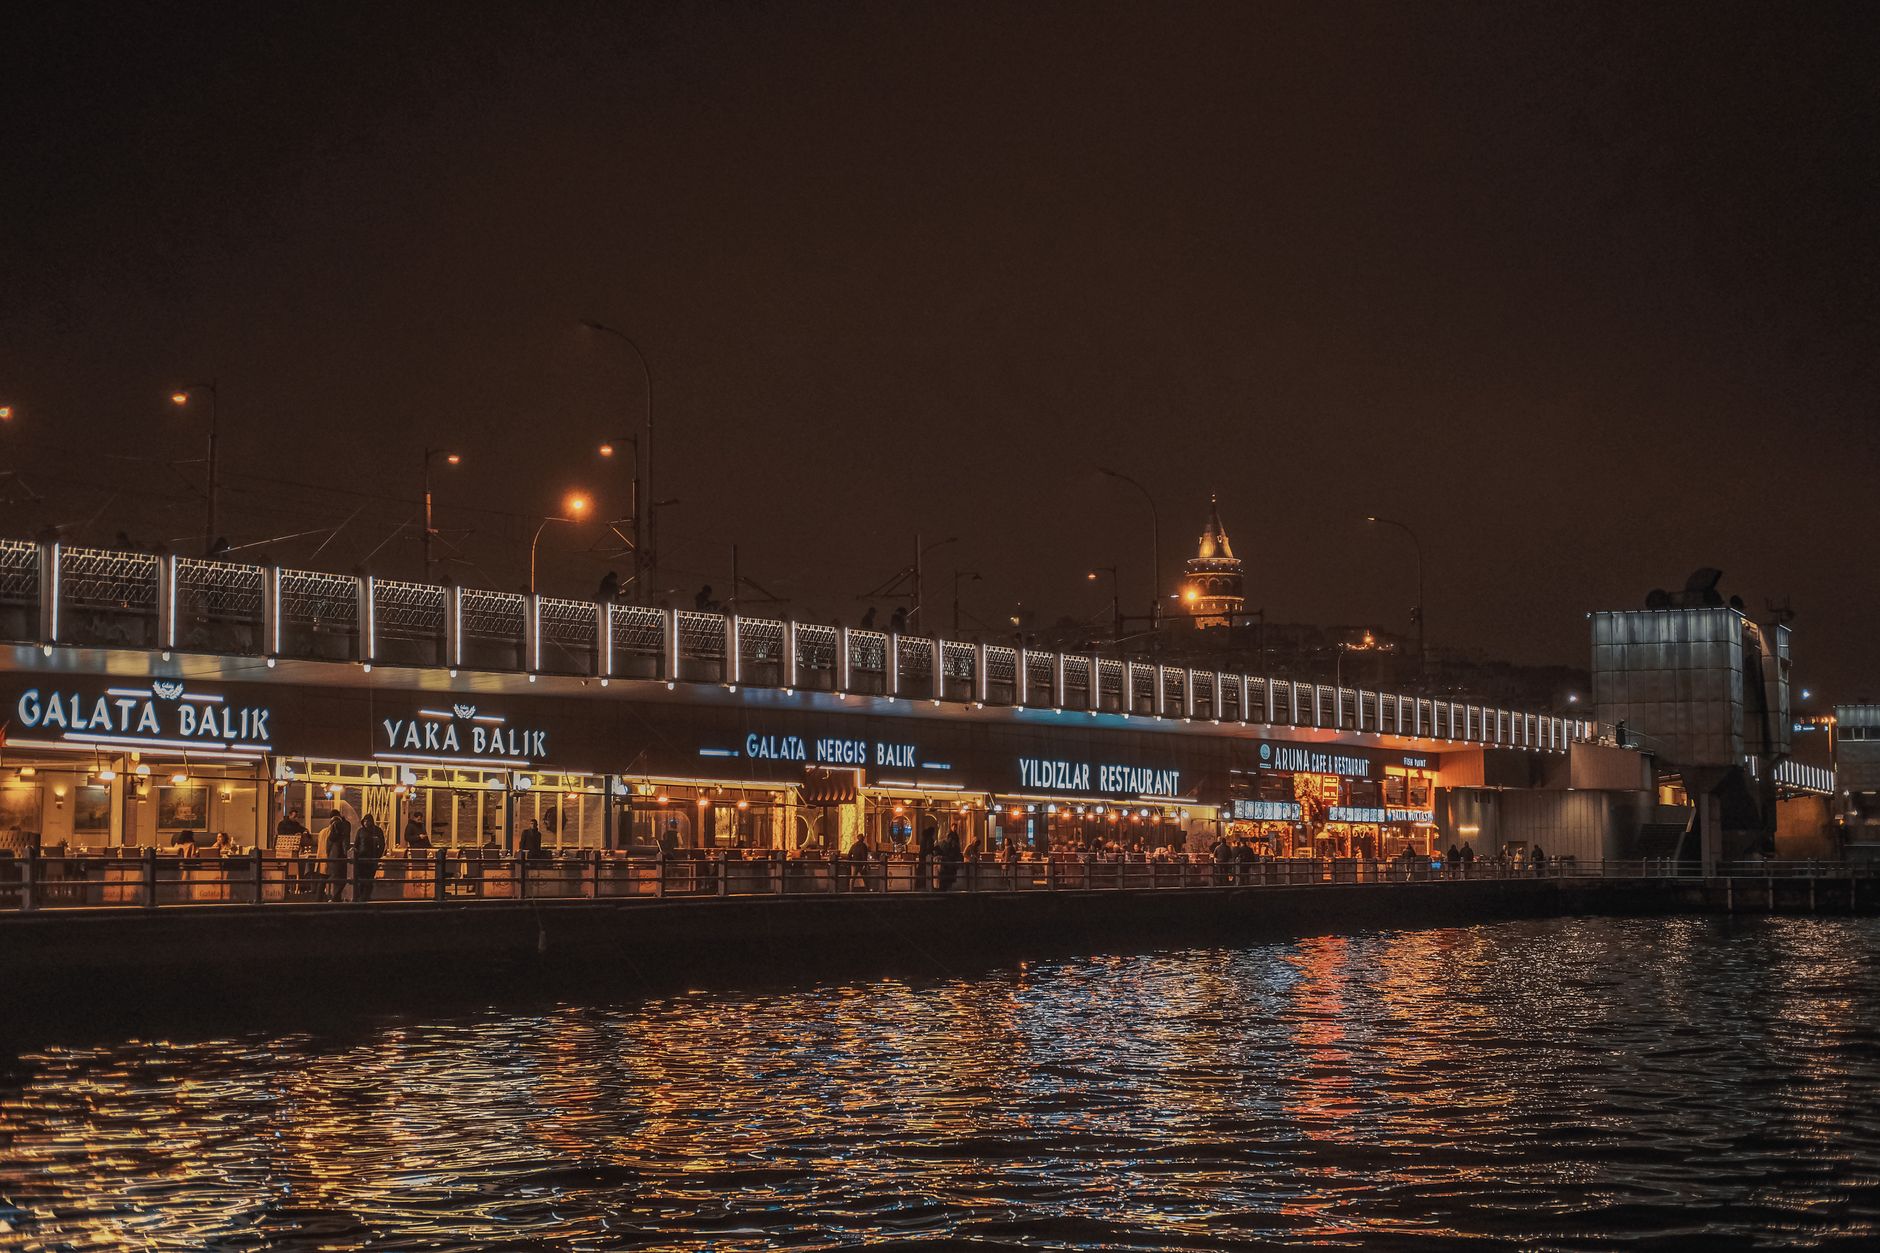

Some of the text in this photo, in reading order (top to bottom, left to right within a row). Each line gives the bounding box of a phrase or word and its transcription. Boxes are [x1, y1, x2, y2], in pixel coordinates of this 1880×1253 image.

[18, 687, 271, 741] GALATA BALIK
[383, 718, 547, 758] YAKA BALIK
[746, 732, 916, 768] GALATA NERGIS BALIK
[1019, 758, 1180, 797] YILDIZLAR RESTAURANT
[1274, 747, 1310, 772] ARUNA
[1311, 752, 1327, 773] CAFE
[1334, 756, 1369, 777] RESTAURANT
